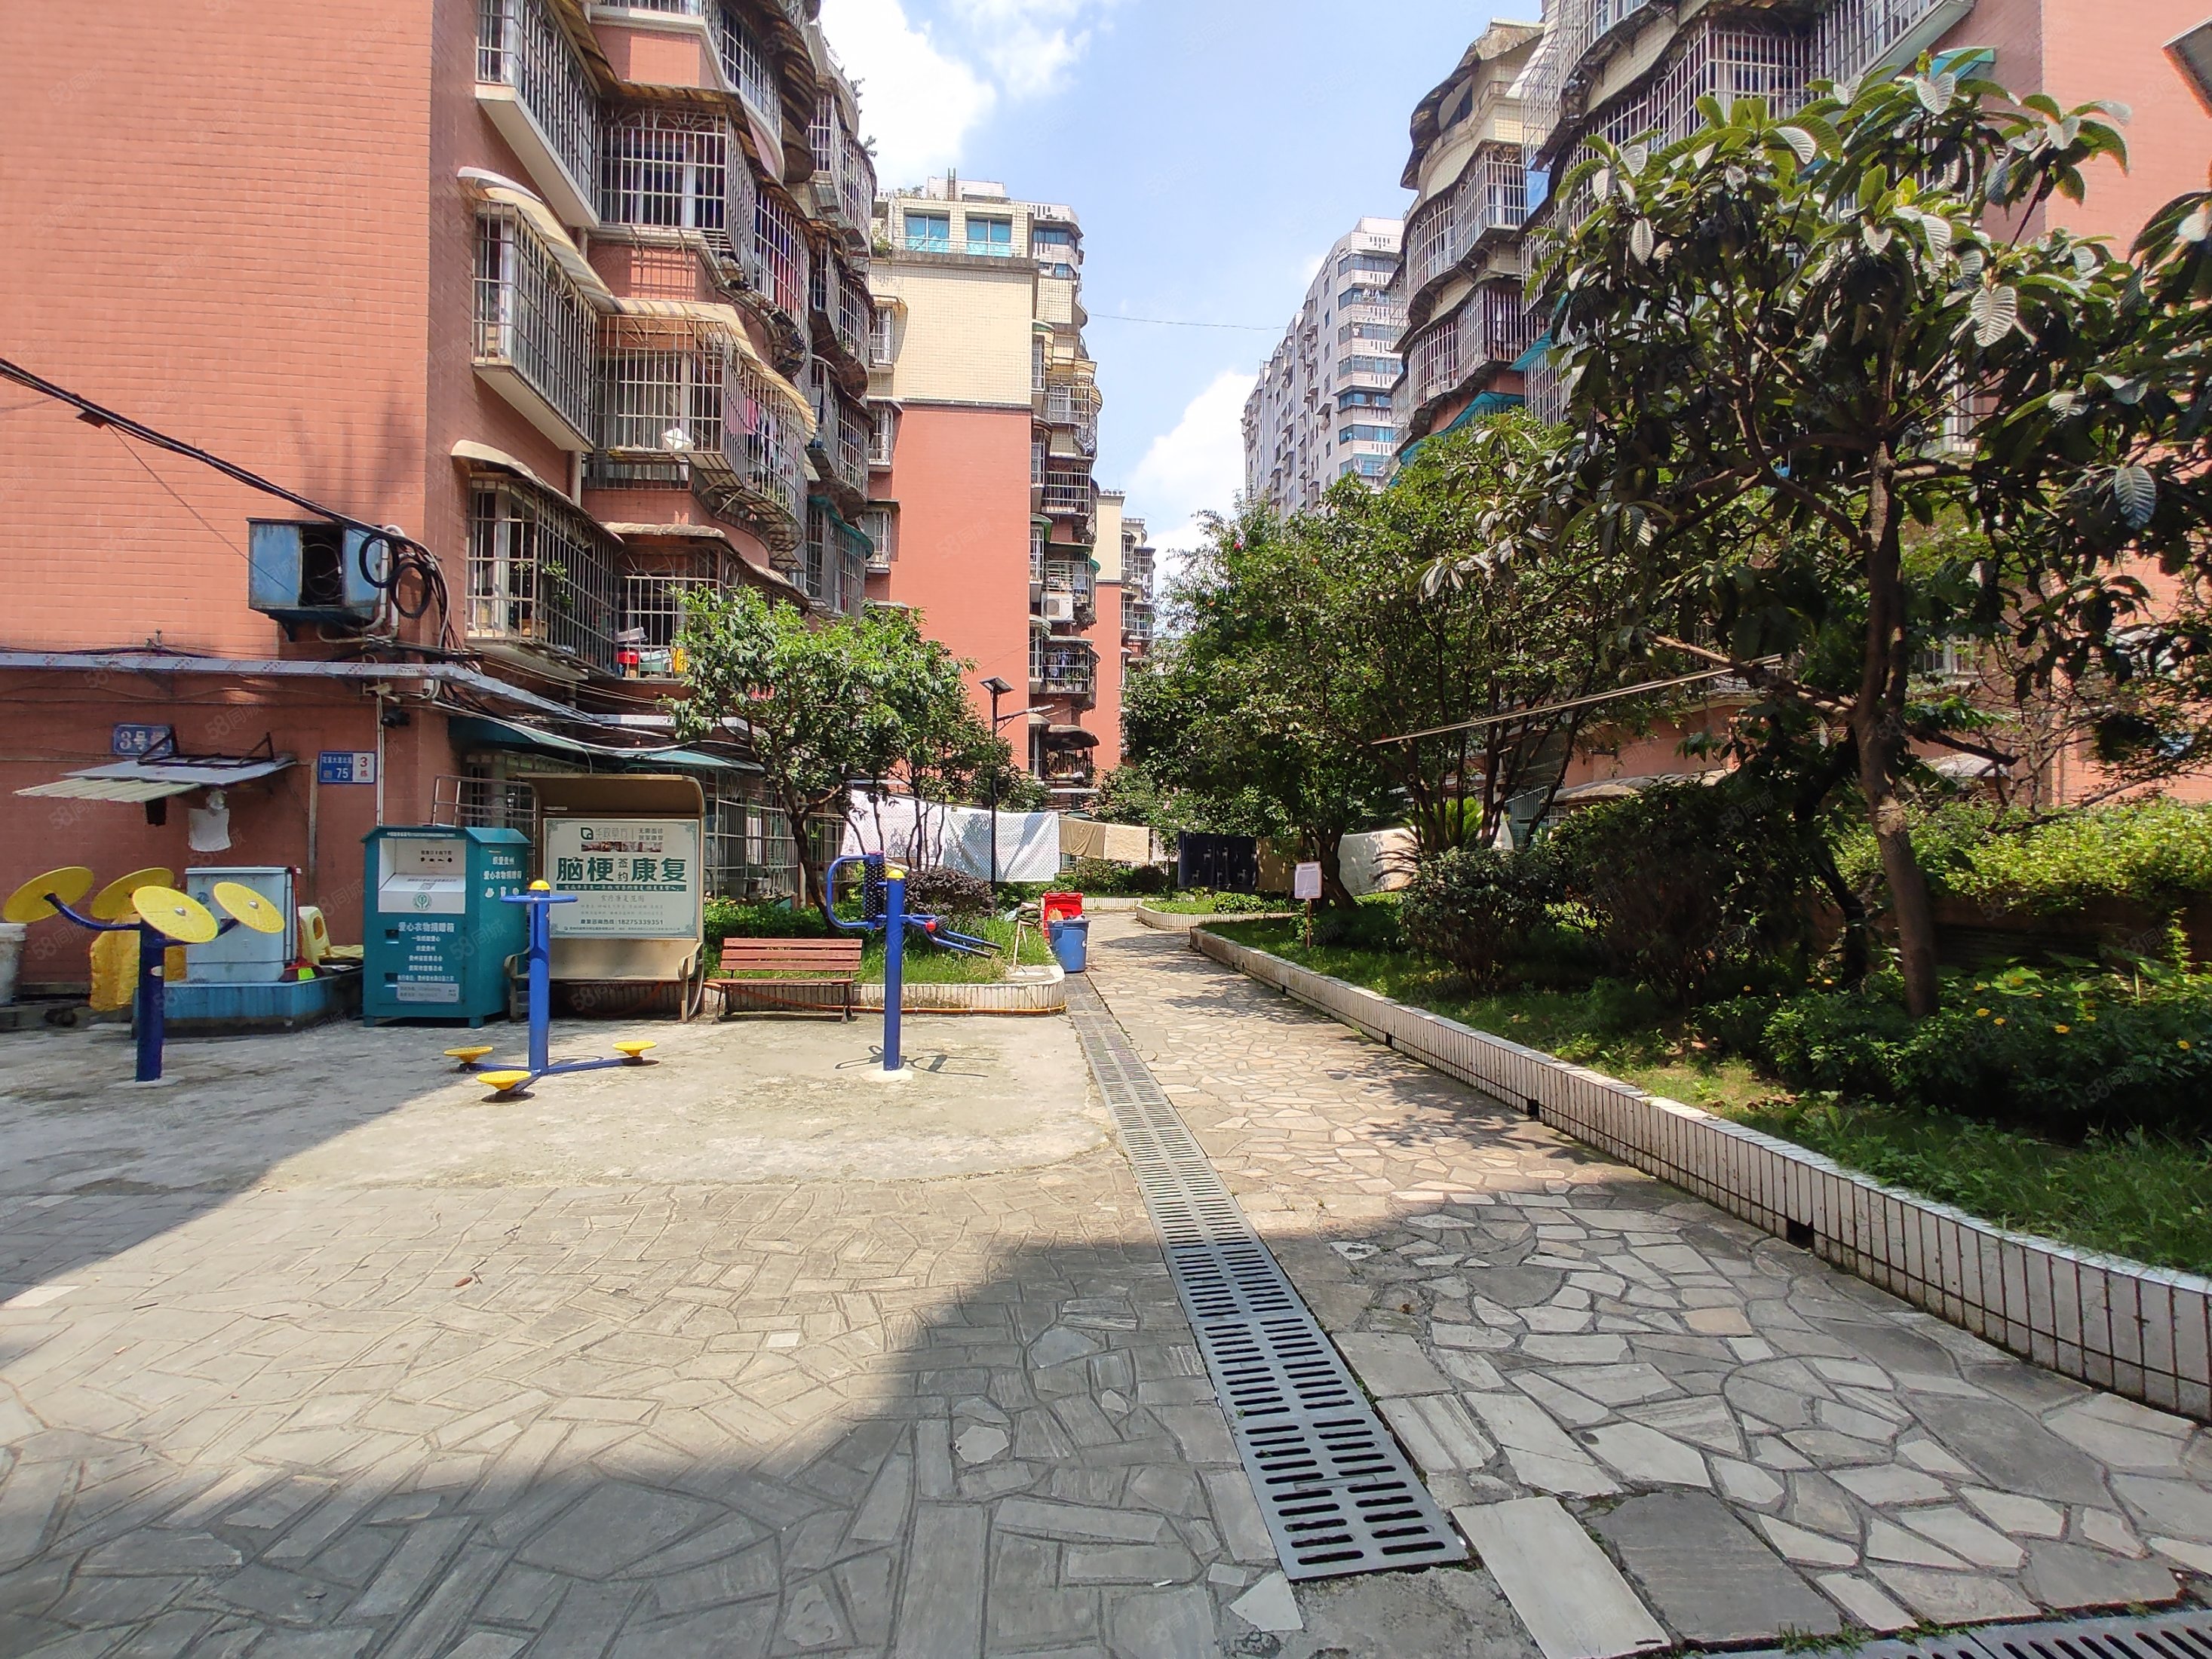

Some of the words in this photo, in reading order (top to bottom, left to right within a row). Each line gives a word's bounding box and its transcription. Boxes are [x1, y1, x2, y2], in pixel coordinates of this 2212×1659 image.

[360, 756, 368, 768] 3
[336, 768, 348, 779] 75
[557, 857, 615, 882] 脑梗
[631, 857, 687, 883] 康复
[397, 921, 455, 934] 爱心衣物捐赠箱
